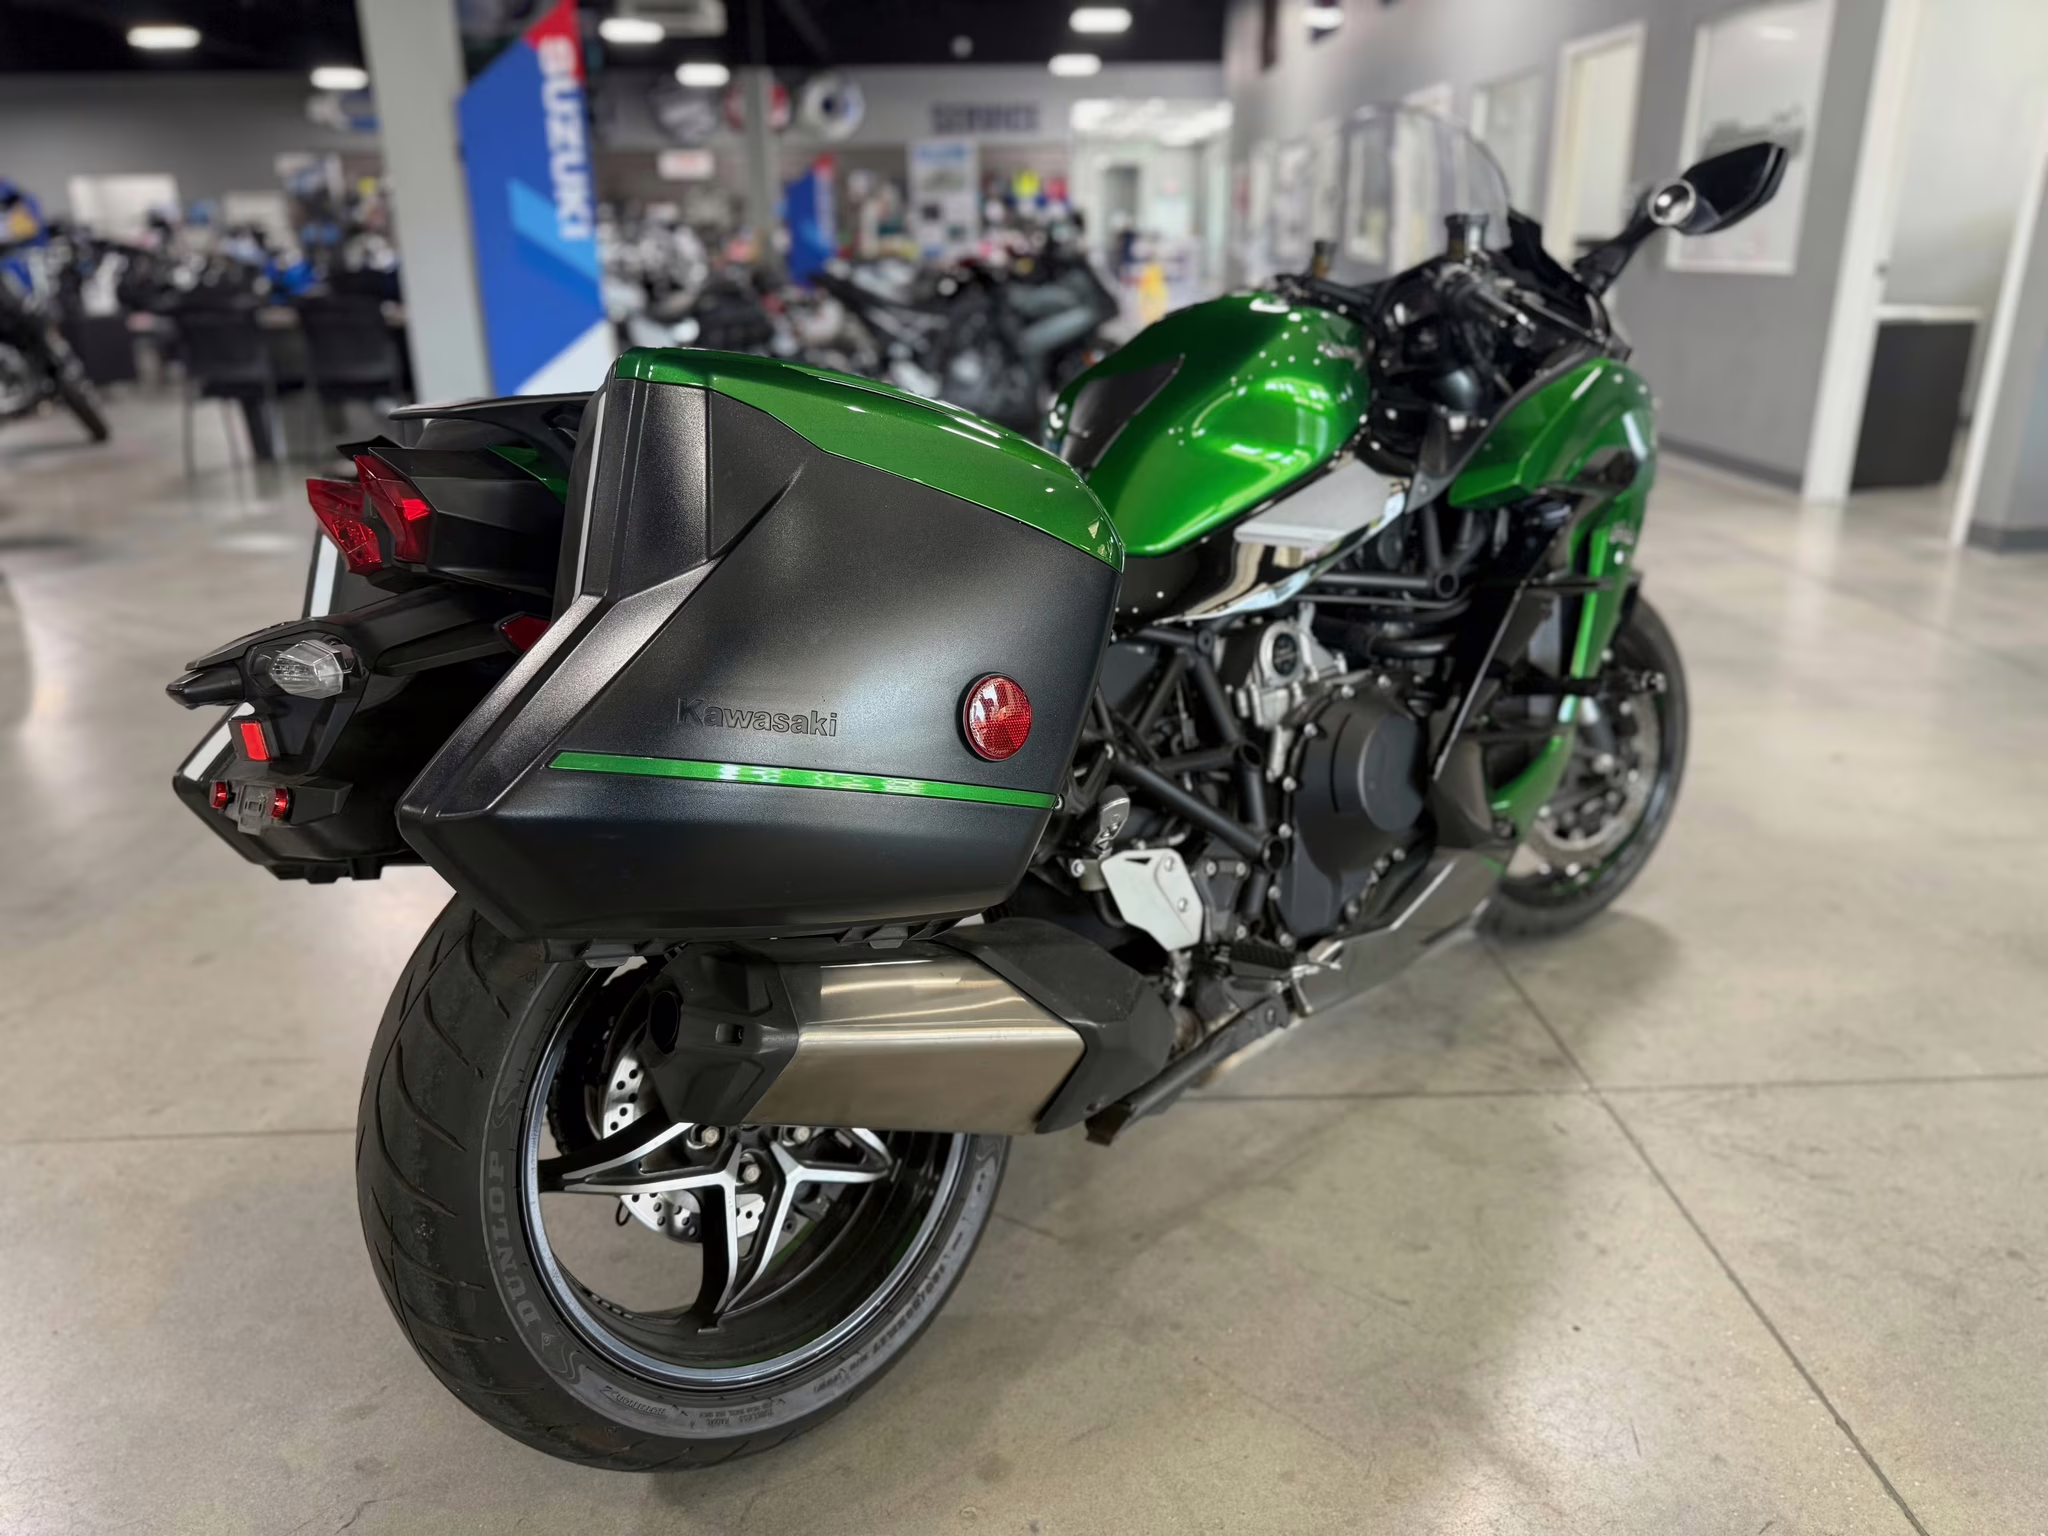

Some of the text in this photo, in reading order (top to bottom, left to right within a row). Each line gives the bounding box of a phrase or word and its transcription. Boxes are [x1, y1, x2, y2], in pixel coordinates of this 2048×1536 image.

[537, 35, 592, 239] SUZUKI
[677, 698, 837, 737] Kawasaki
[489, 1151, 541, 1328] DUNLOP
